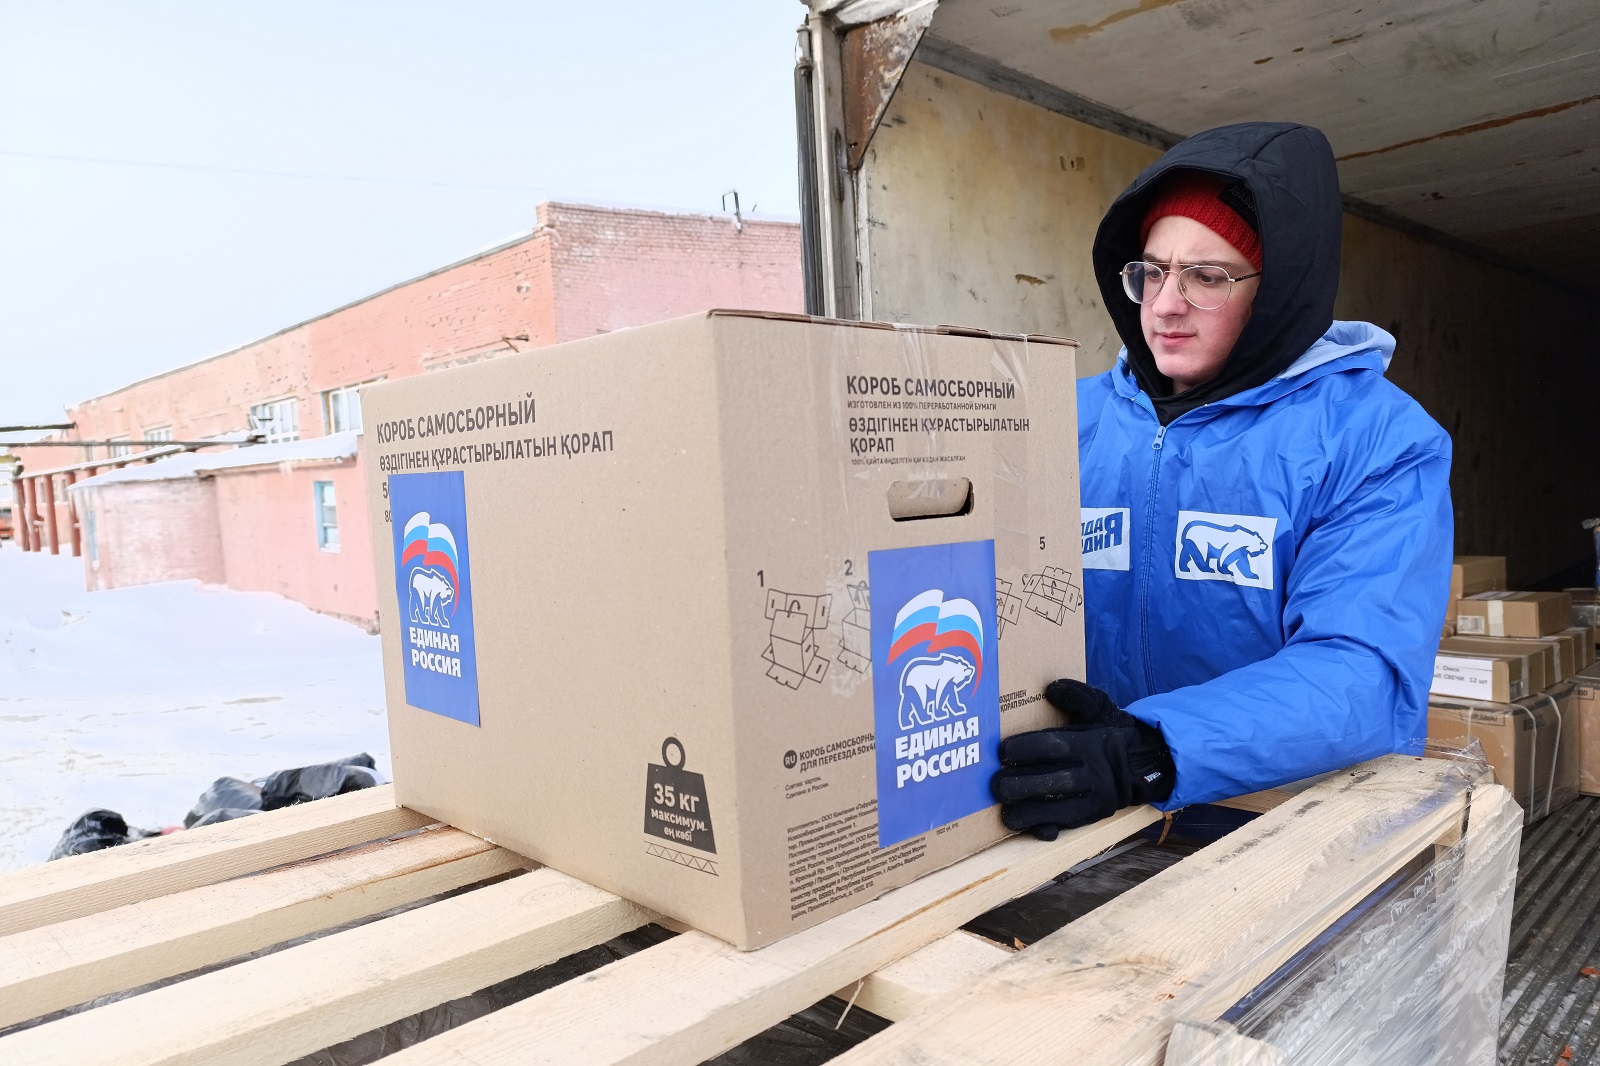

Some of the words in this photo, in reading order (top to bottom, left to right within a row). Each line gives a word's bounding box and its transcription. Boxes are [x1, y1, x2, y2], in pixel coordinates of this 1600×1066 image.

[846, 376, 900, 396] КОРОБ
[904, 378, 1014, 399] САМОСБОРНЫЙ
[848, 401, 891, 409] ИЗГОТОВЛЕН
[902, 402, 918, 410] 100%
[918, 401, 974, 410] ПЕРЕРАБОТАННОЙ
[376, 418, 415, 444] КОРОБ
[418, 392, 536, 438] САМОСБОРНЫЙ
[849, 418, 918, 435] ӨЗДІГІНЕН
[380, 451, 430, 474] ӨЗДІГІНЕН
[560, 430, 614, 459] ҚОРАП
[850, 437, 894, 456] ҚОРАП
[1039, 536, 1046, 550] 5
[757, 570, 764, 588] 1
[844, 560, 853, 576] 2
[409, 626, 460, 653] ЕДИНАЯ
[412, 648, 462, 678] РОССИЯ
[895, 716, 980, 760] ЕДИНАЯ
[800, 746, 826, 761] КОРОБ
[800, 759, 818, 774] ДЛЯ
[818, 748, 857, 766] ПЕРЕЕЗДА
[896, 742, 980, 788] РОССИЯ
[653, 782, 676, 808] 35
